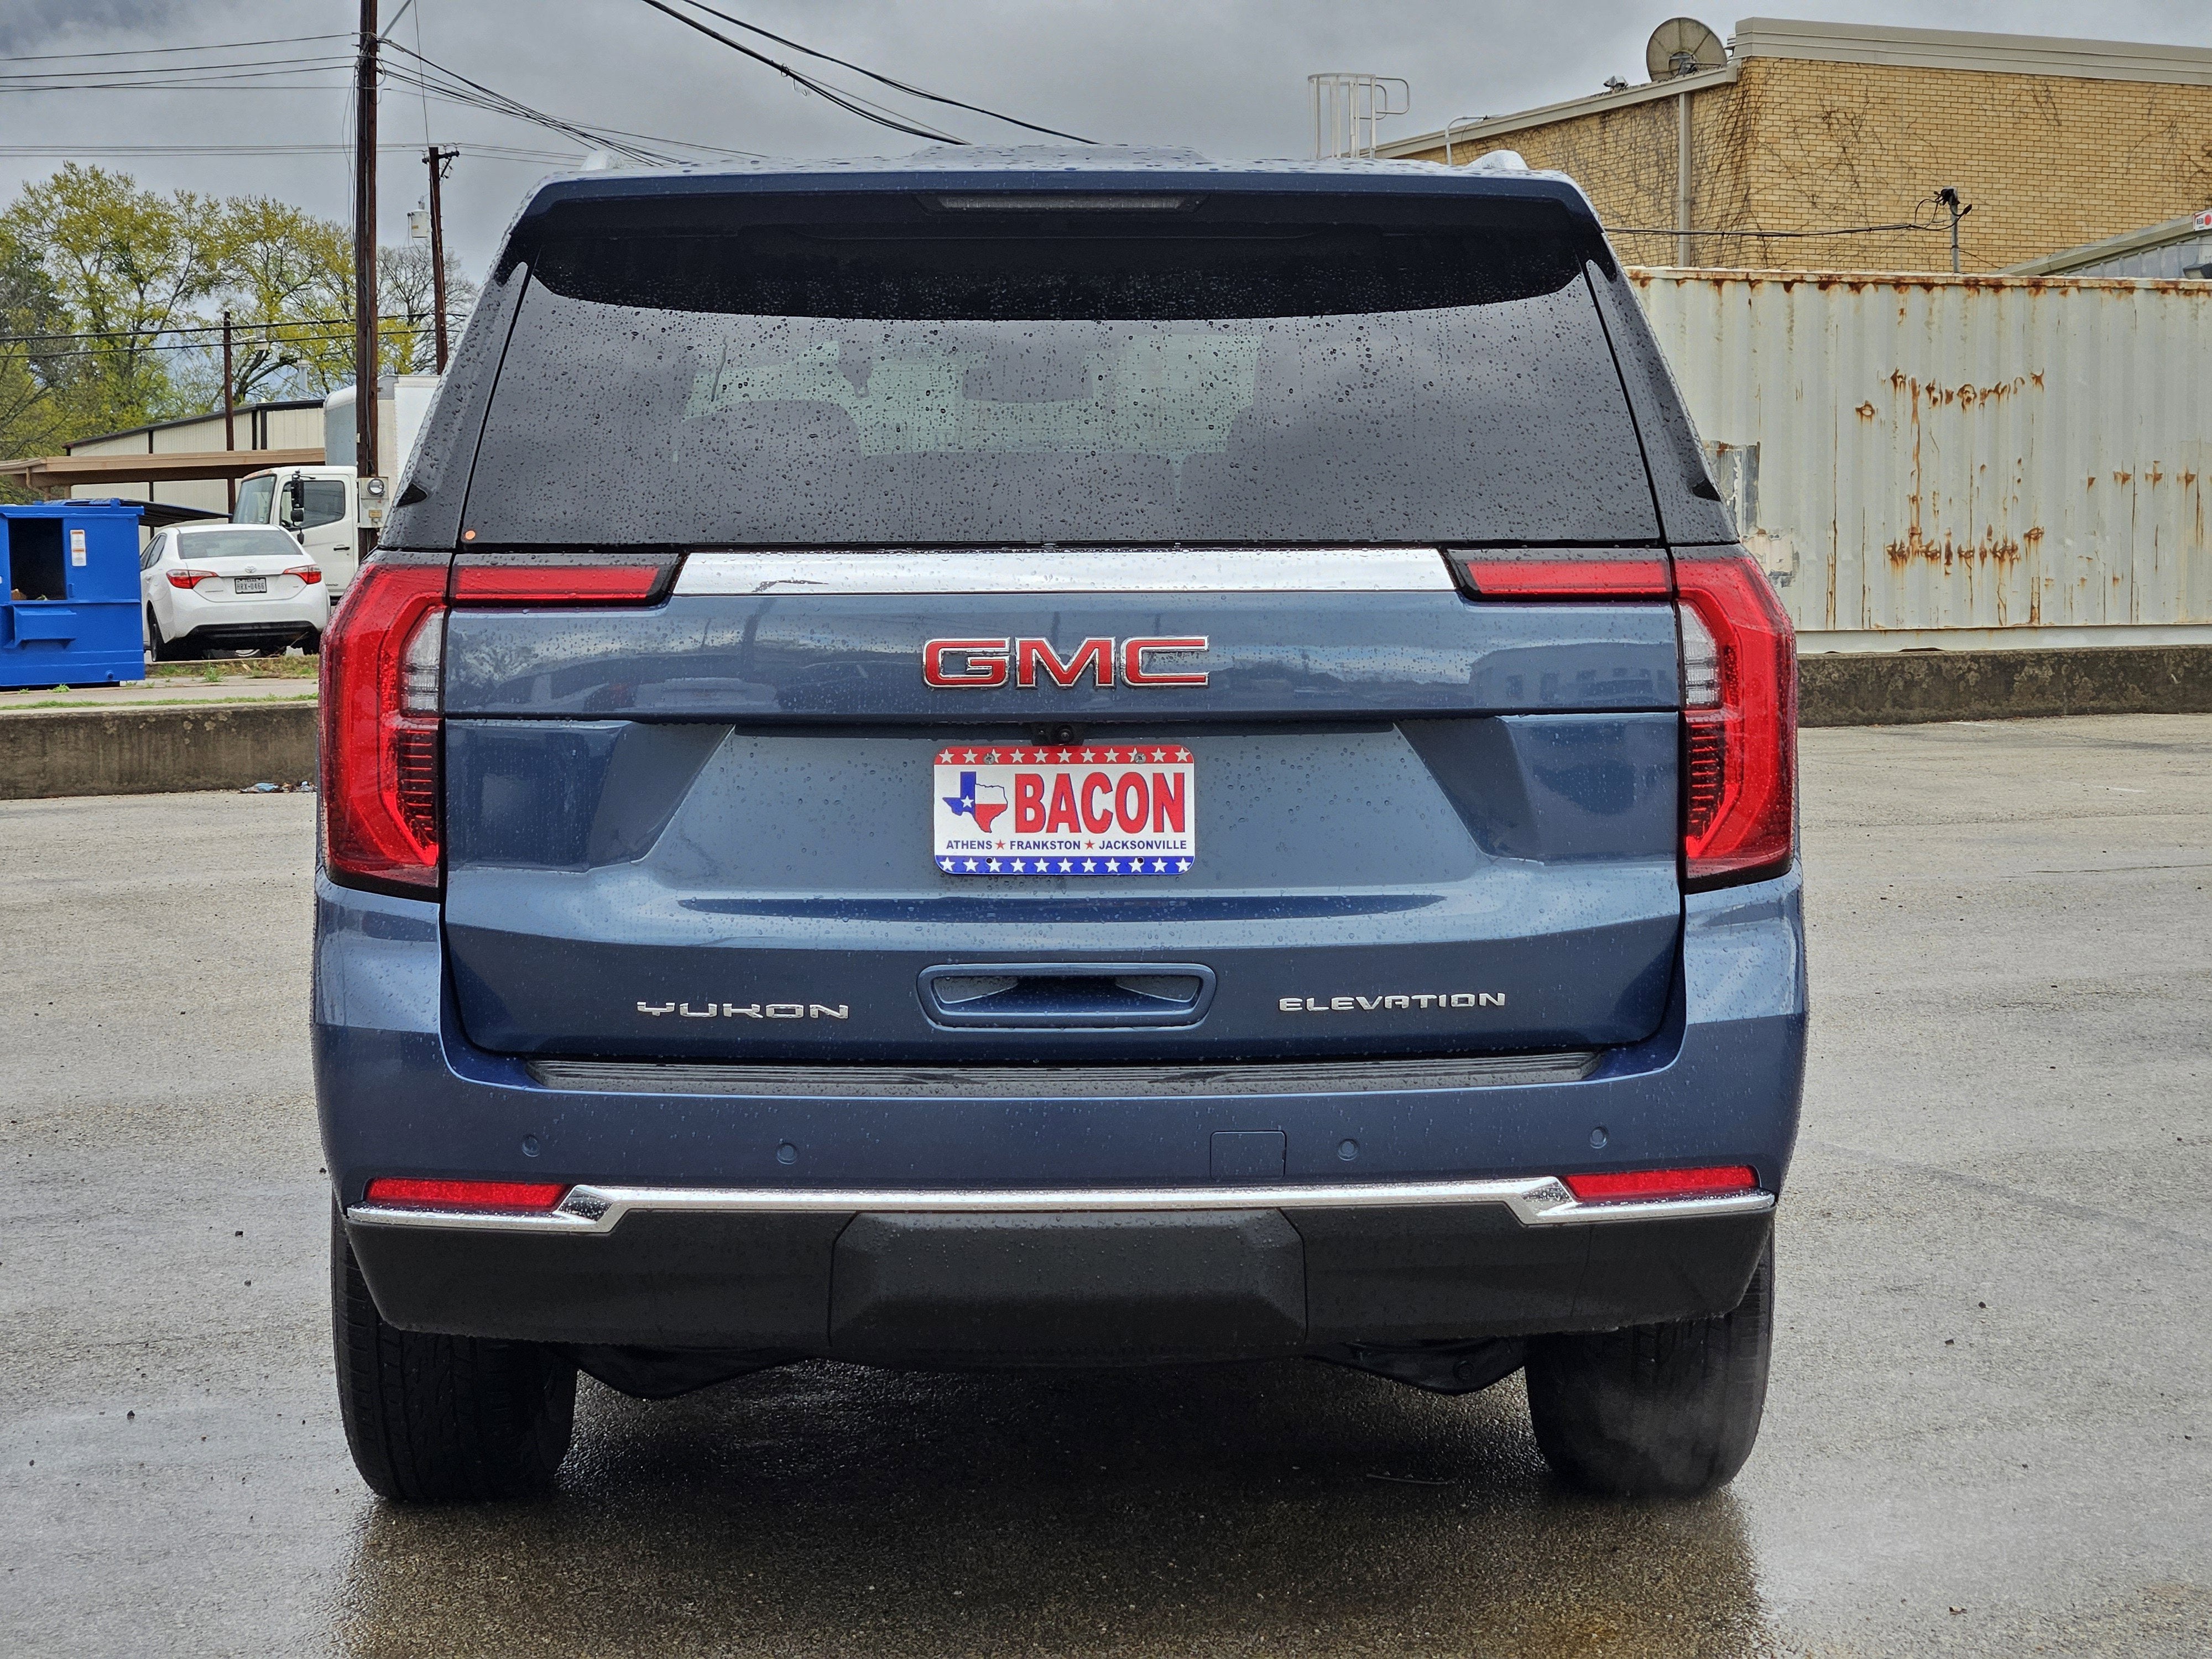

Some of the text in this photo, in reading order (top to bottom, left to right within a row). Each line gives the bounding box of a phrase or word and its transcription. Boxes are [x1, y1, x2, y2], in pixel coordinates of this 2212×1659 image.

[922, 636, 1209, 688] GMC
[1014, 771, 1186, 834] BACON
[946, 839, 1187, 850] ATHENS FRANKSTON JACKSONVILLE
[637, 1001, 848, 1019] YUKON
[1279, 993, 1506, 1011] ELEVATION
